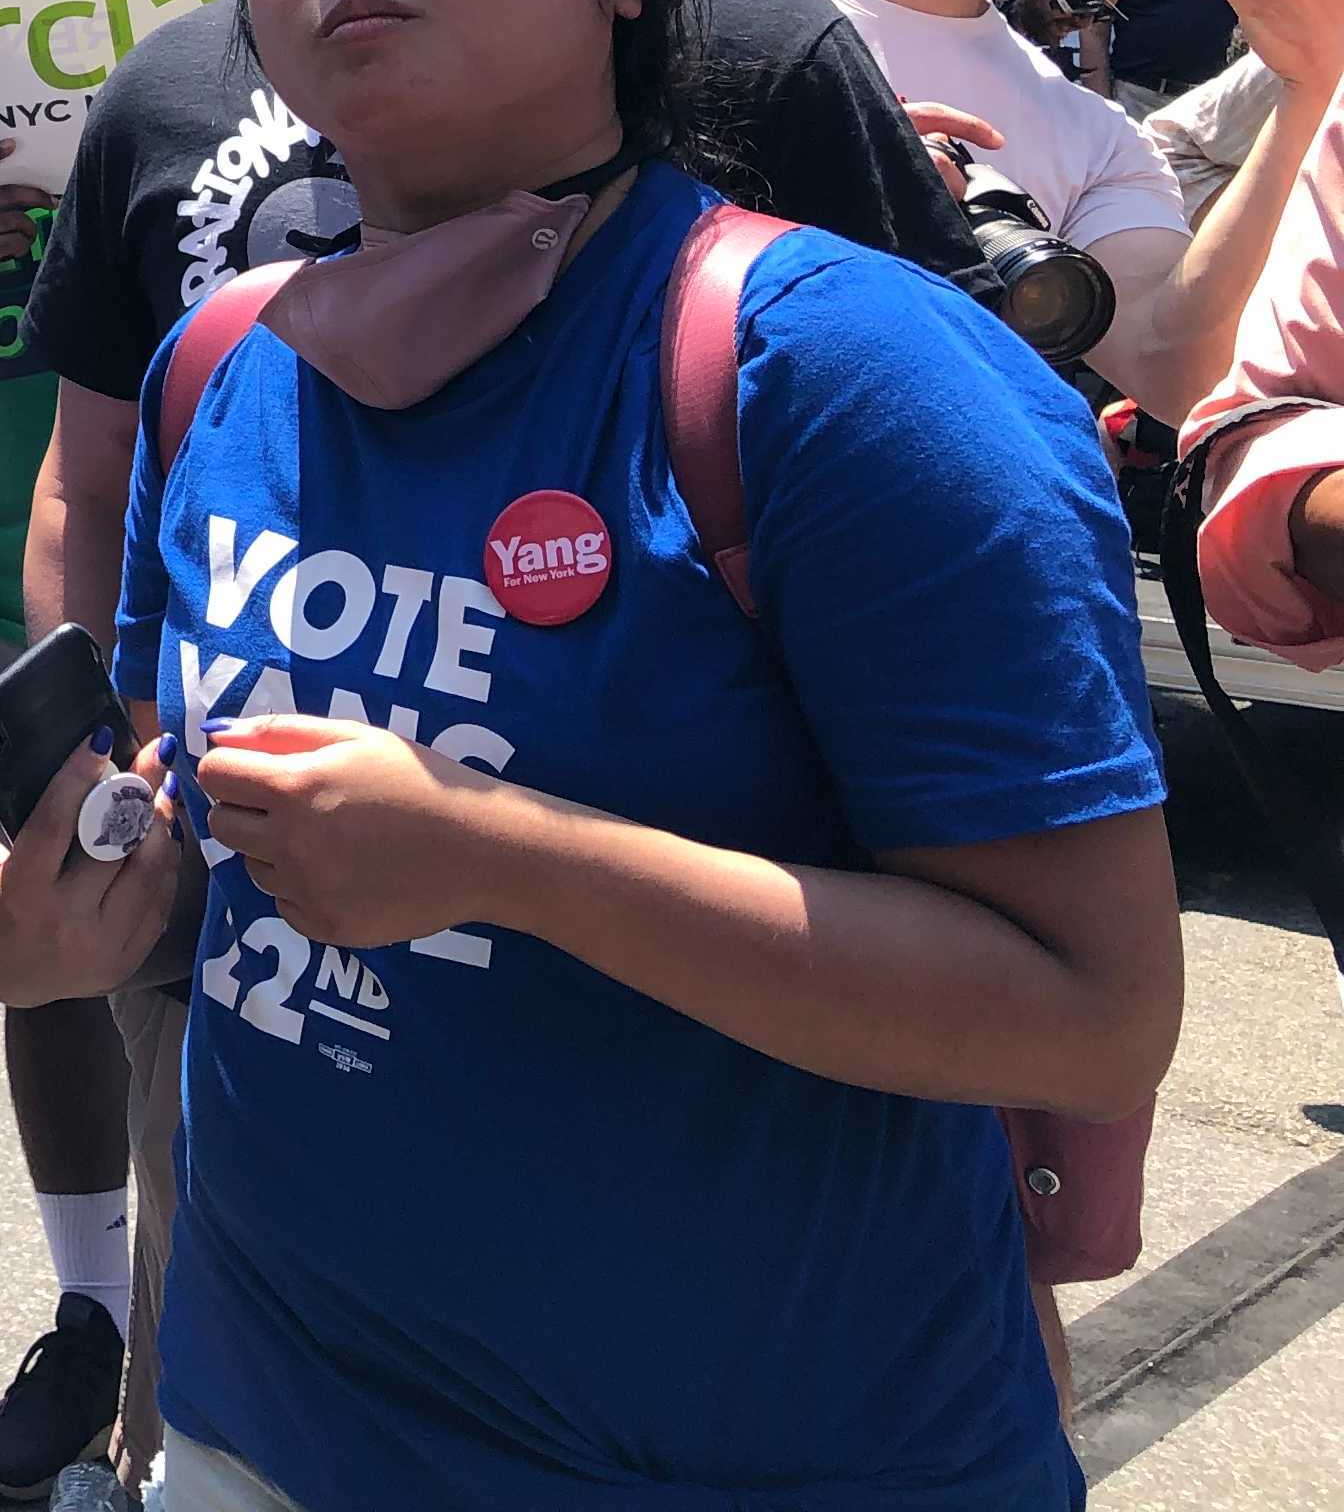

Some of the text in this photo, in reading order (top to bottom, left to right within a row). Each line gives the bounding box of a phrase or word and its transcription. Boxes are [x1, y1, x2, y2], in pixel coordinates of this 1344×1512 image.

[490, 531, 608, 575] Yang
[503, 568, 575, 588] For New York
[206, 514, 508, 704] VOTE
